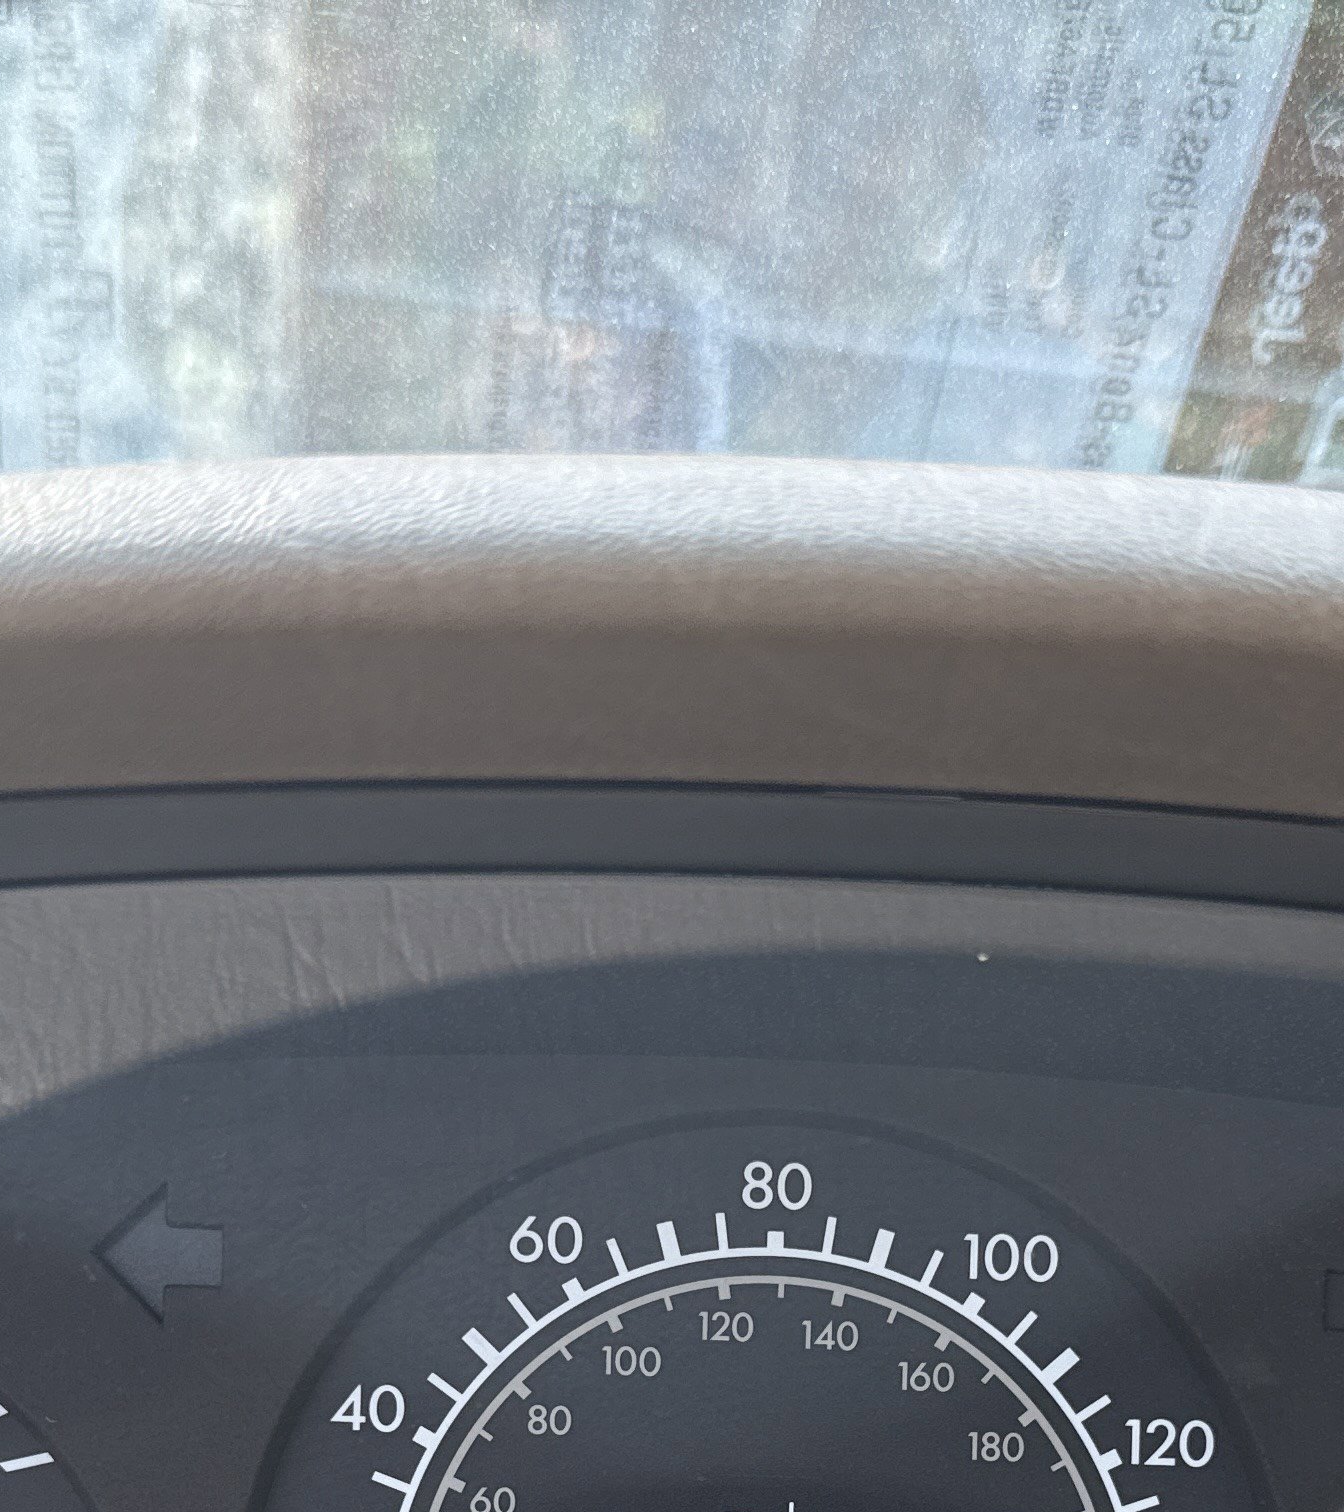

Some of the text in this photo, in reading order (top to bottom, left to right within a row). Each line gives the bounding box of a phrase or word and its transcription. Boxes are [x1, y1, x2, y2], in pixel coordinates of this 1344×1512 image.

[741, 1160, 813, 1211] 80
[509, 1215, 584, 1264] 60
[964, 1233, 1059, 1283] 100
[699, 1310, 754, 1342] 120
[802, 1320, 859, 1352] 140
[602, 1345, 662, 1377] 100
[898, 1361, 955, 1393] 160
[329, 1383, 406, 1433] 40
[527, 1404, 573, 1437] 80
[967, 1431, 1025, 1463] 180
[1125, 1418, 1216, 1468] 120
